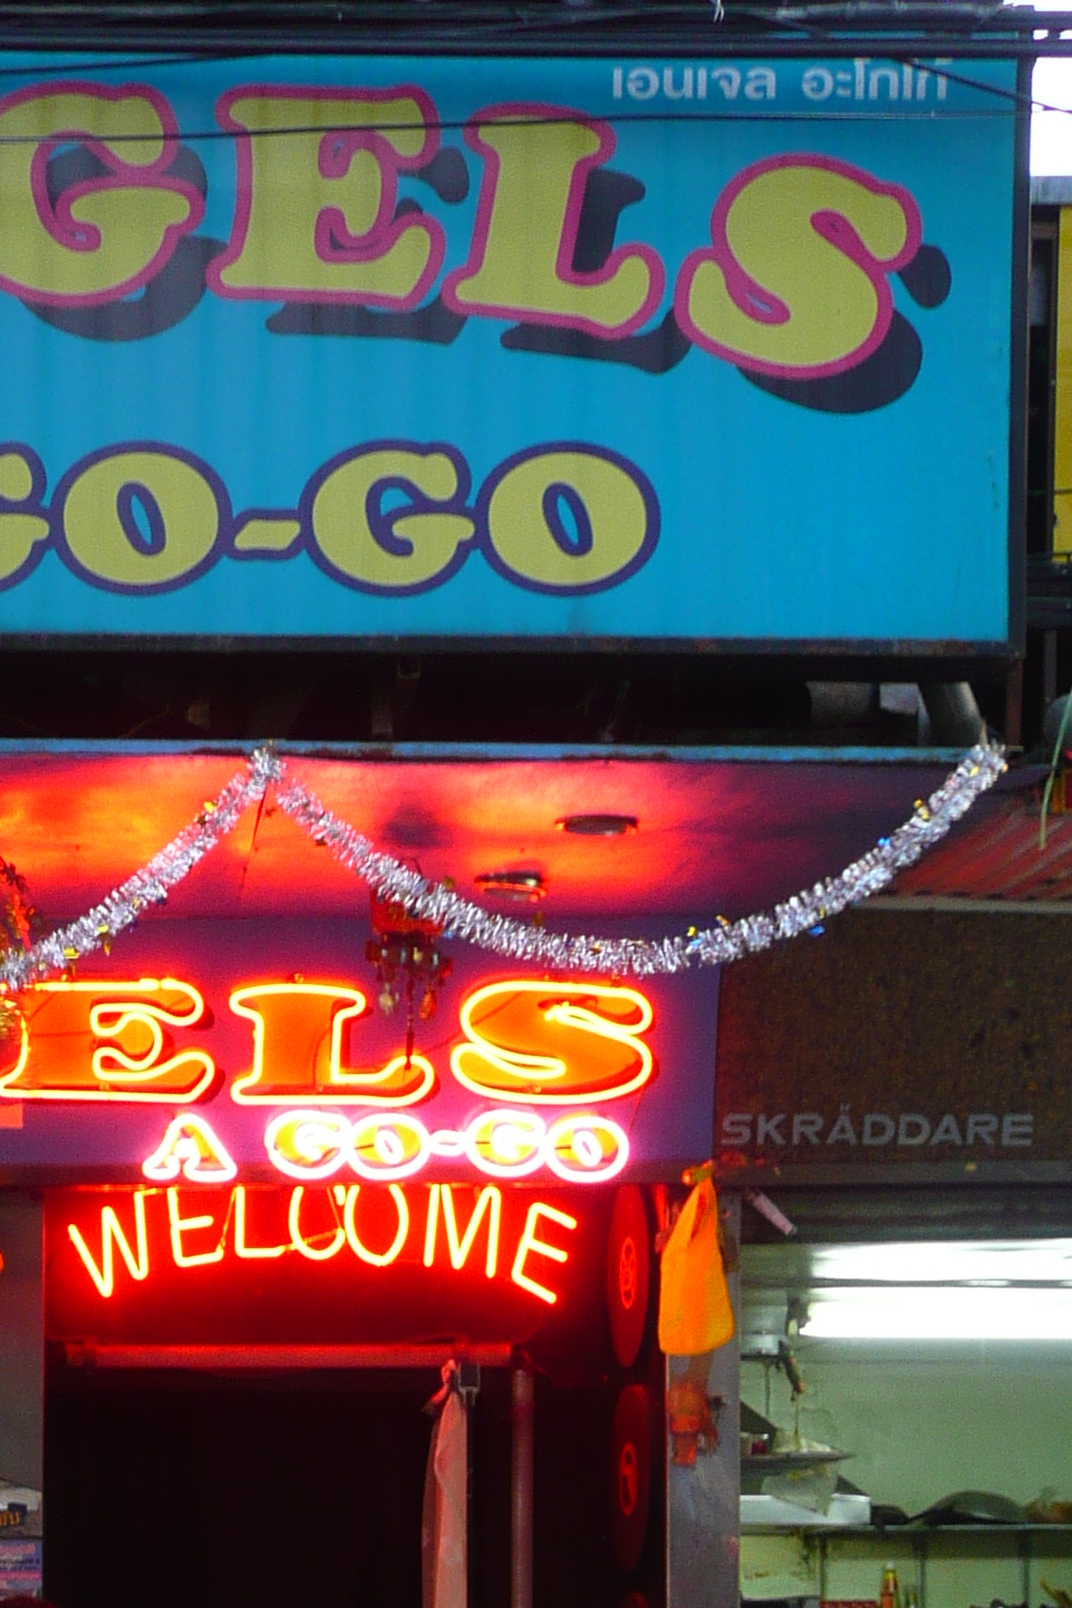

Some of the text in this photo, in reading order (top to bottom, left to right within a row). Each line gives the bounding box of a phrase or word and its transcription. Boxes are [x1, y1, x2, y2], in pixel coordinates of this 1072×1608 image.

[612, 65, 777, 101] เอนเจล
[141, 1108, 630, 1184] A GO-GO
[721, 1103, 1035, 1147] SKRÄDDARE
[65, 1182, 578, 1306] WELCOME
